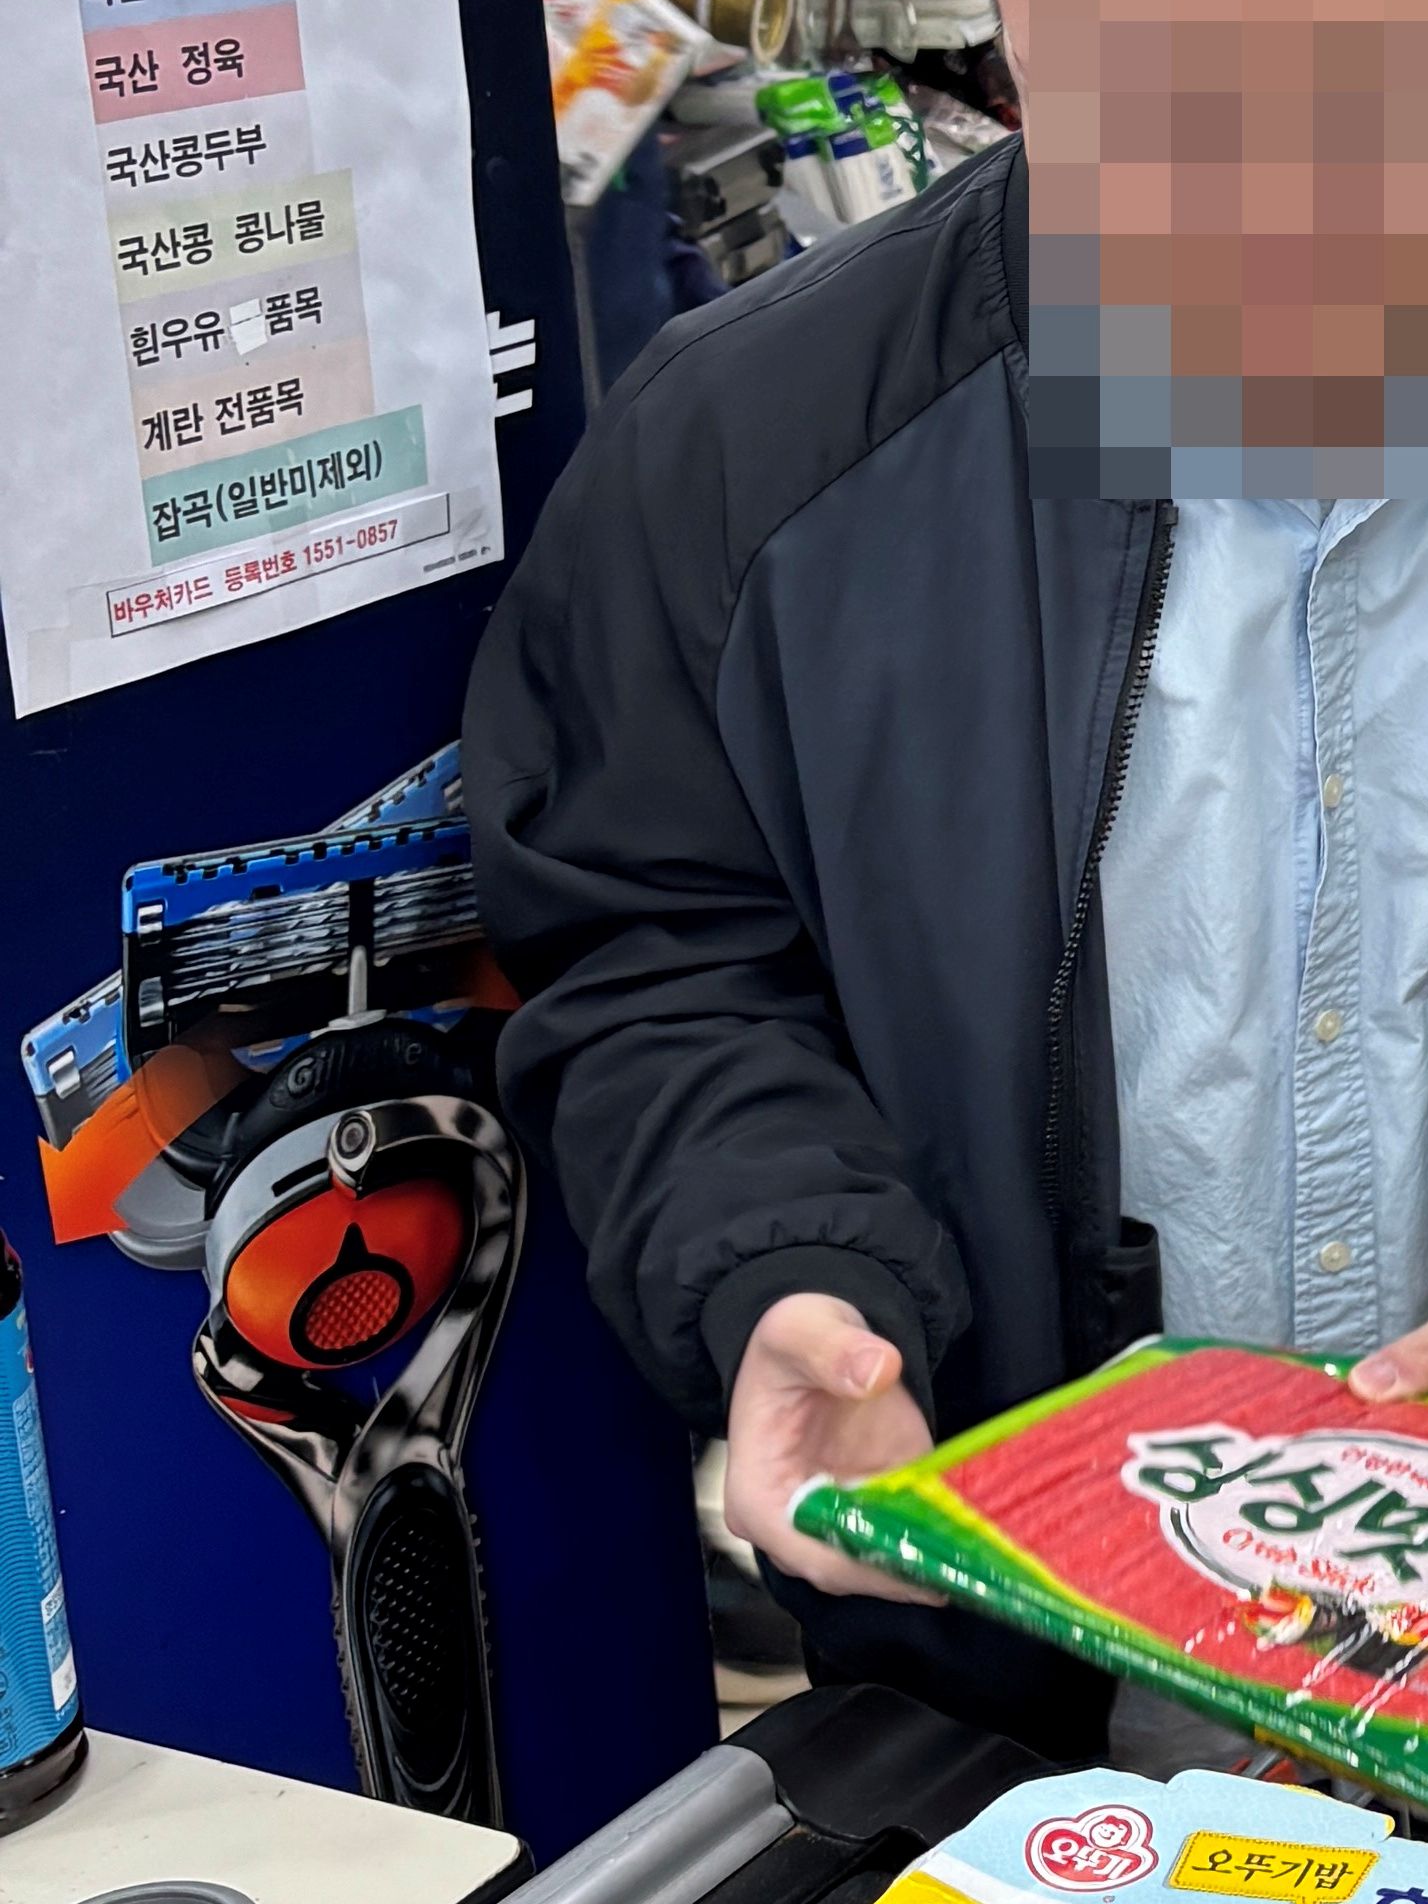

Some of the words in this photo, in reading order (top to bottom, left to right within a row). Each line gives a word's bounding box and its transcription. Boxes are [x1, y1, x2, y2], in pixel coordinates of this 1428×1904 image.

[94, 49, 160, 98] 국산
[181, 39, 245, 86] 정육
[106, 123, 268, 189] 국산콩두부
[118, 222, 215, 276] 국산콩
[234, 200, 326, 256] 콩나물
[130, 311, 226, 368] 흰우유
[265, 287, 324, 335] 품목
[142, 404, 204, 454] 계란
[215, 377, 305, 437] 전품목
[153, 439, 385, 544] 잡곡(일반미제외)
[113, 576, 215, 624] 바우처카드
[224, 549, 298, 594] 등록번호
[302, 519, 399, 567] 1551-0857
[1044, 1838, 1132, 1880] 오뚜기
[1193, 1848, 1354, 1890] 오뚜기밥
